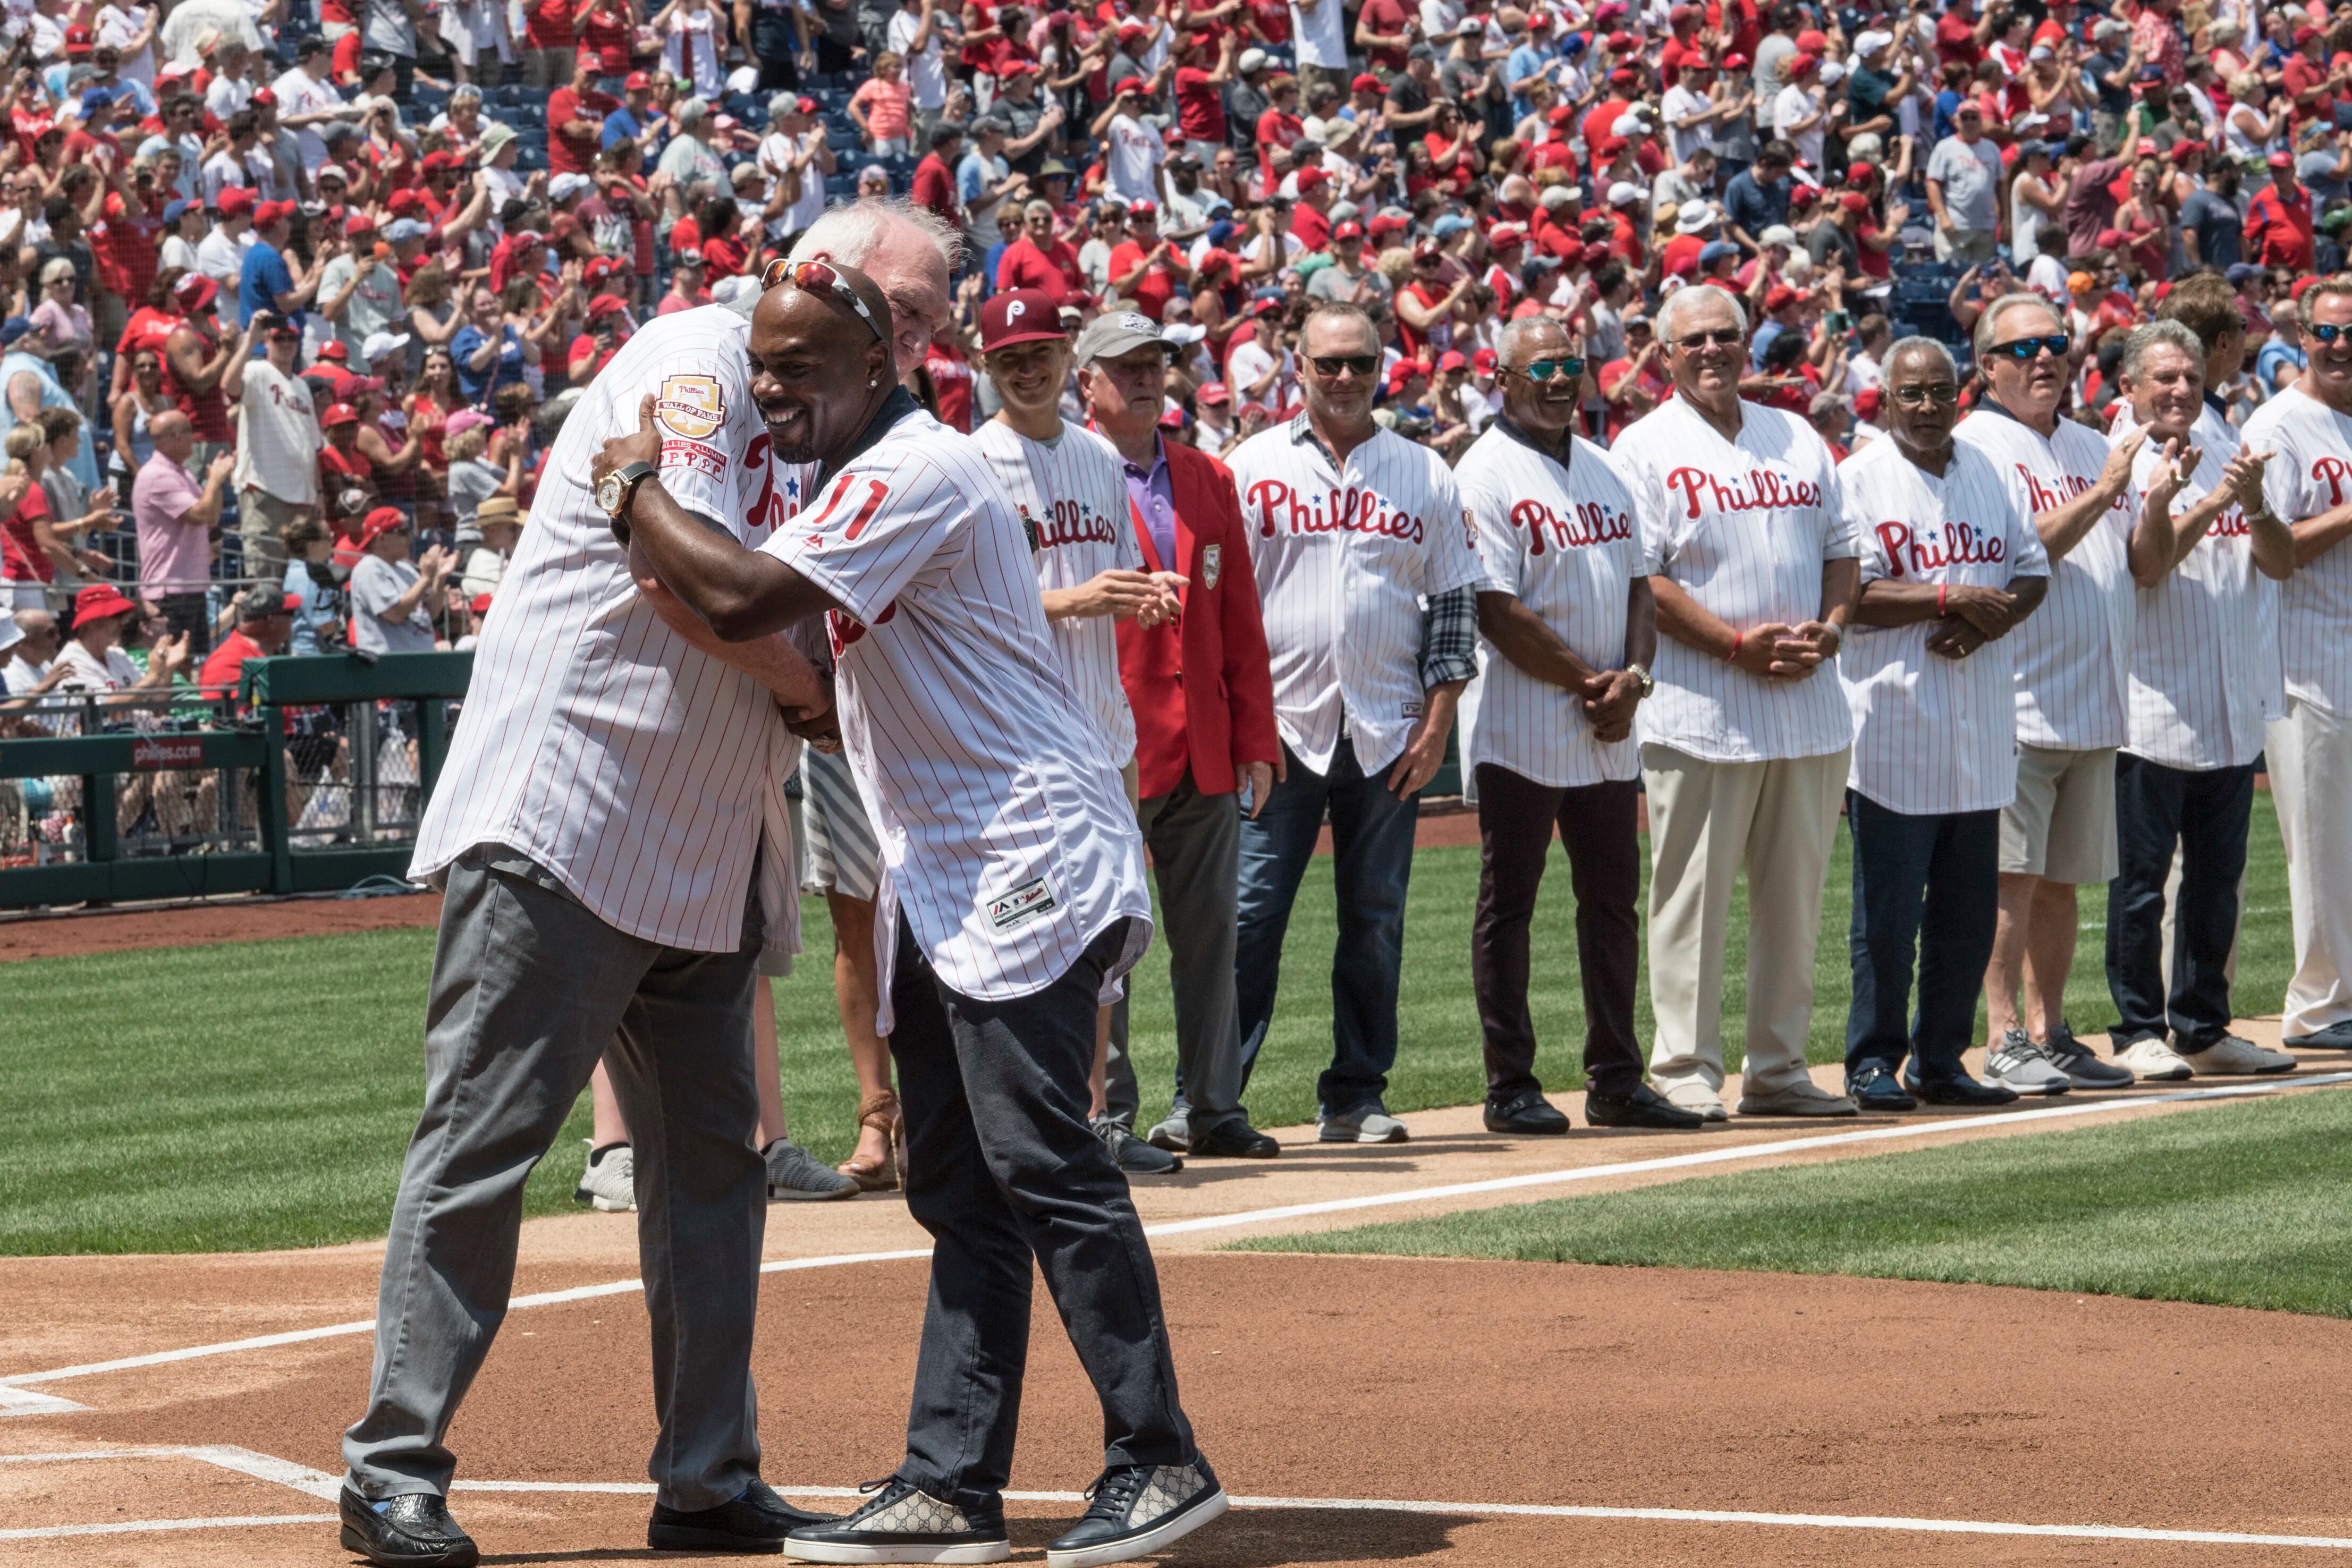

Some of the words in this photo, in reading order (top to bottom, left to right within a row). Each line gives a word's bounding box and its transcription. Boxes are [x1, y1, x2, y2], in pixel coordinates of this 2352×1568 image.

[1007, 300, 1026, 326] P
[679, 385, 704, 394] Phillies
[662, 402, 685, 411] WALL
[685, 406, 697, 415] OF
[697, 409, 717, 420] FAME
[662, 440, 692, 450] ILLIES
[695, 445, 725, 463] ALUMNI
[684, 452, 697, 466] P
[1667, 467, 1822, 519] Phillies
[813, 474, 889, 541] 11
[1247, 479, 1424, 545] Phillies
[1511, 499, 1632, 555] Phillie
[1876, 521, 2007, 577] Phillie
[994, 909, 1013, 920] Majestic
